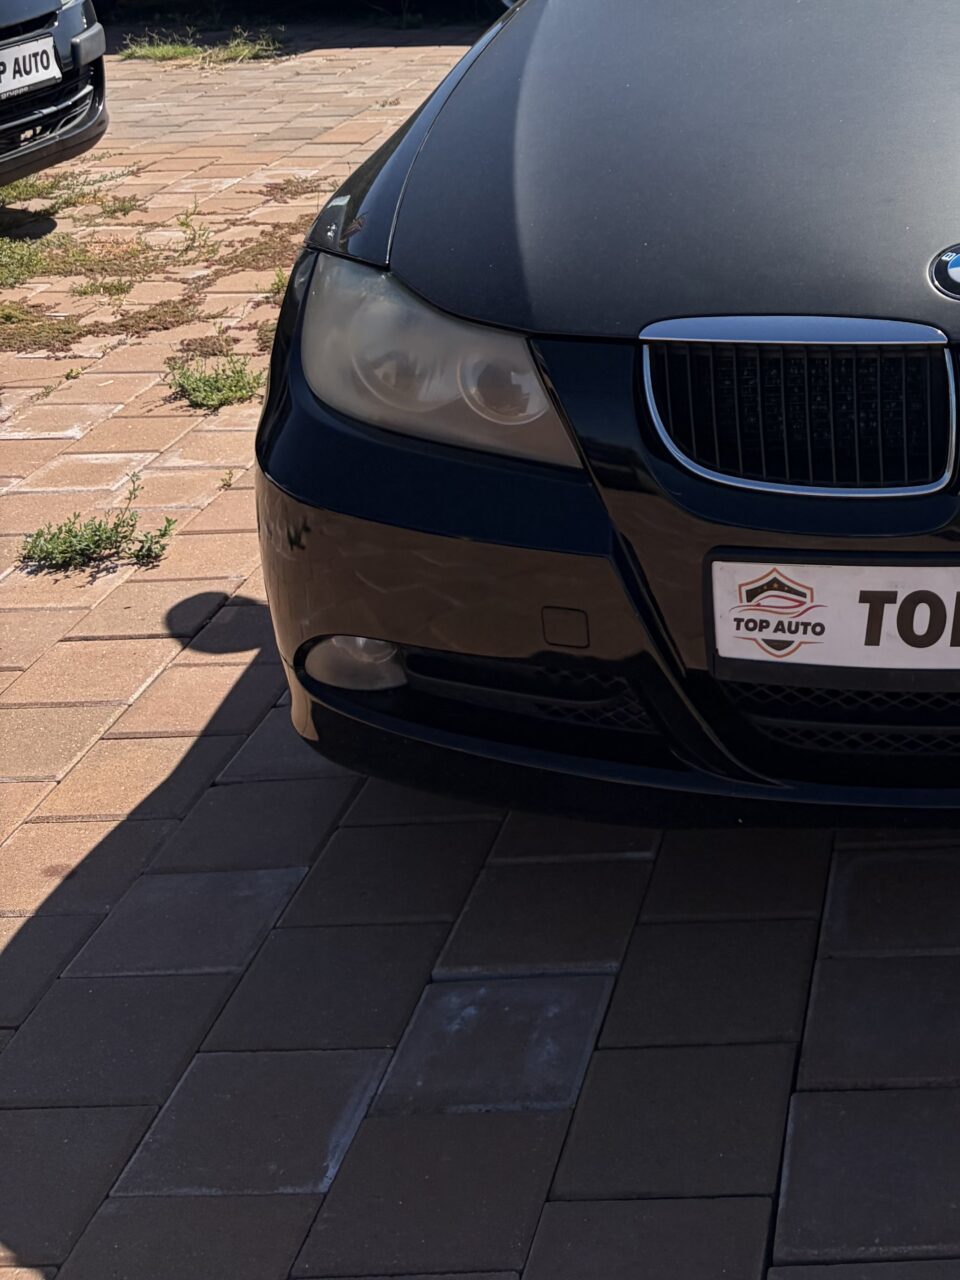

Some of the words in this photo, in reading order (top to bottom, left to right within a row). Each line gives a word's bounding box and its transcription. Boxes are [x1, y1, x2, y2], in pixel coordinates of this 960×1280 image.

[12, 49, 51, 80] AUTO
[733, 617, 770, 633] TOP
[773, 620, 826, 636] AUTO
